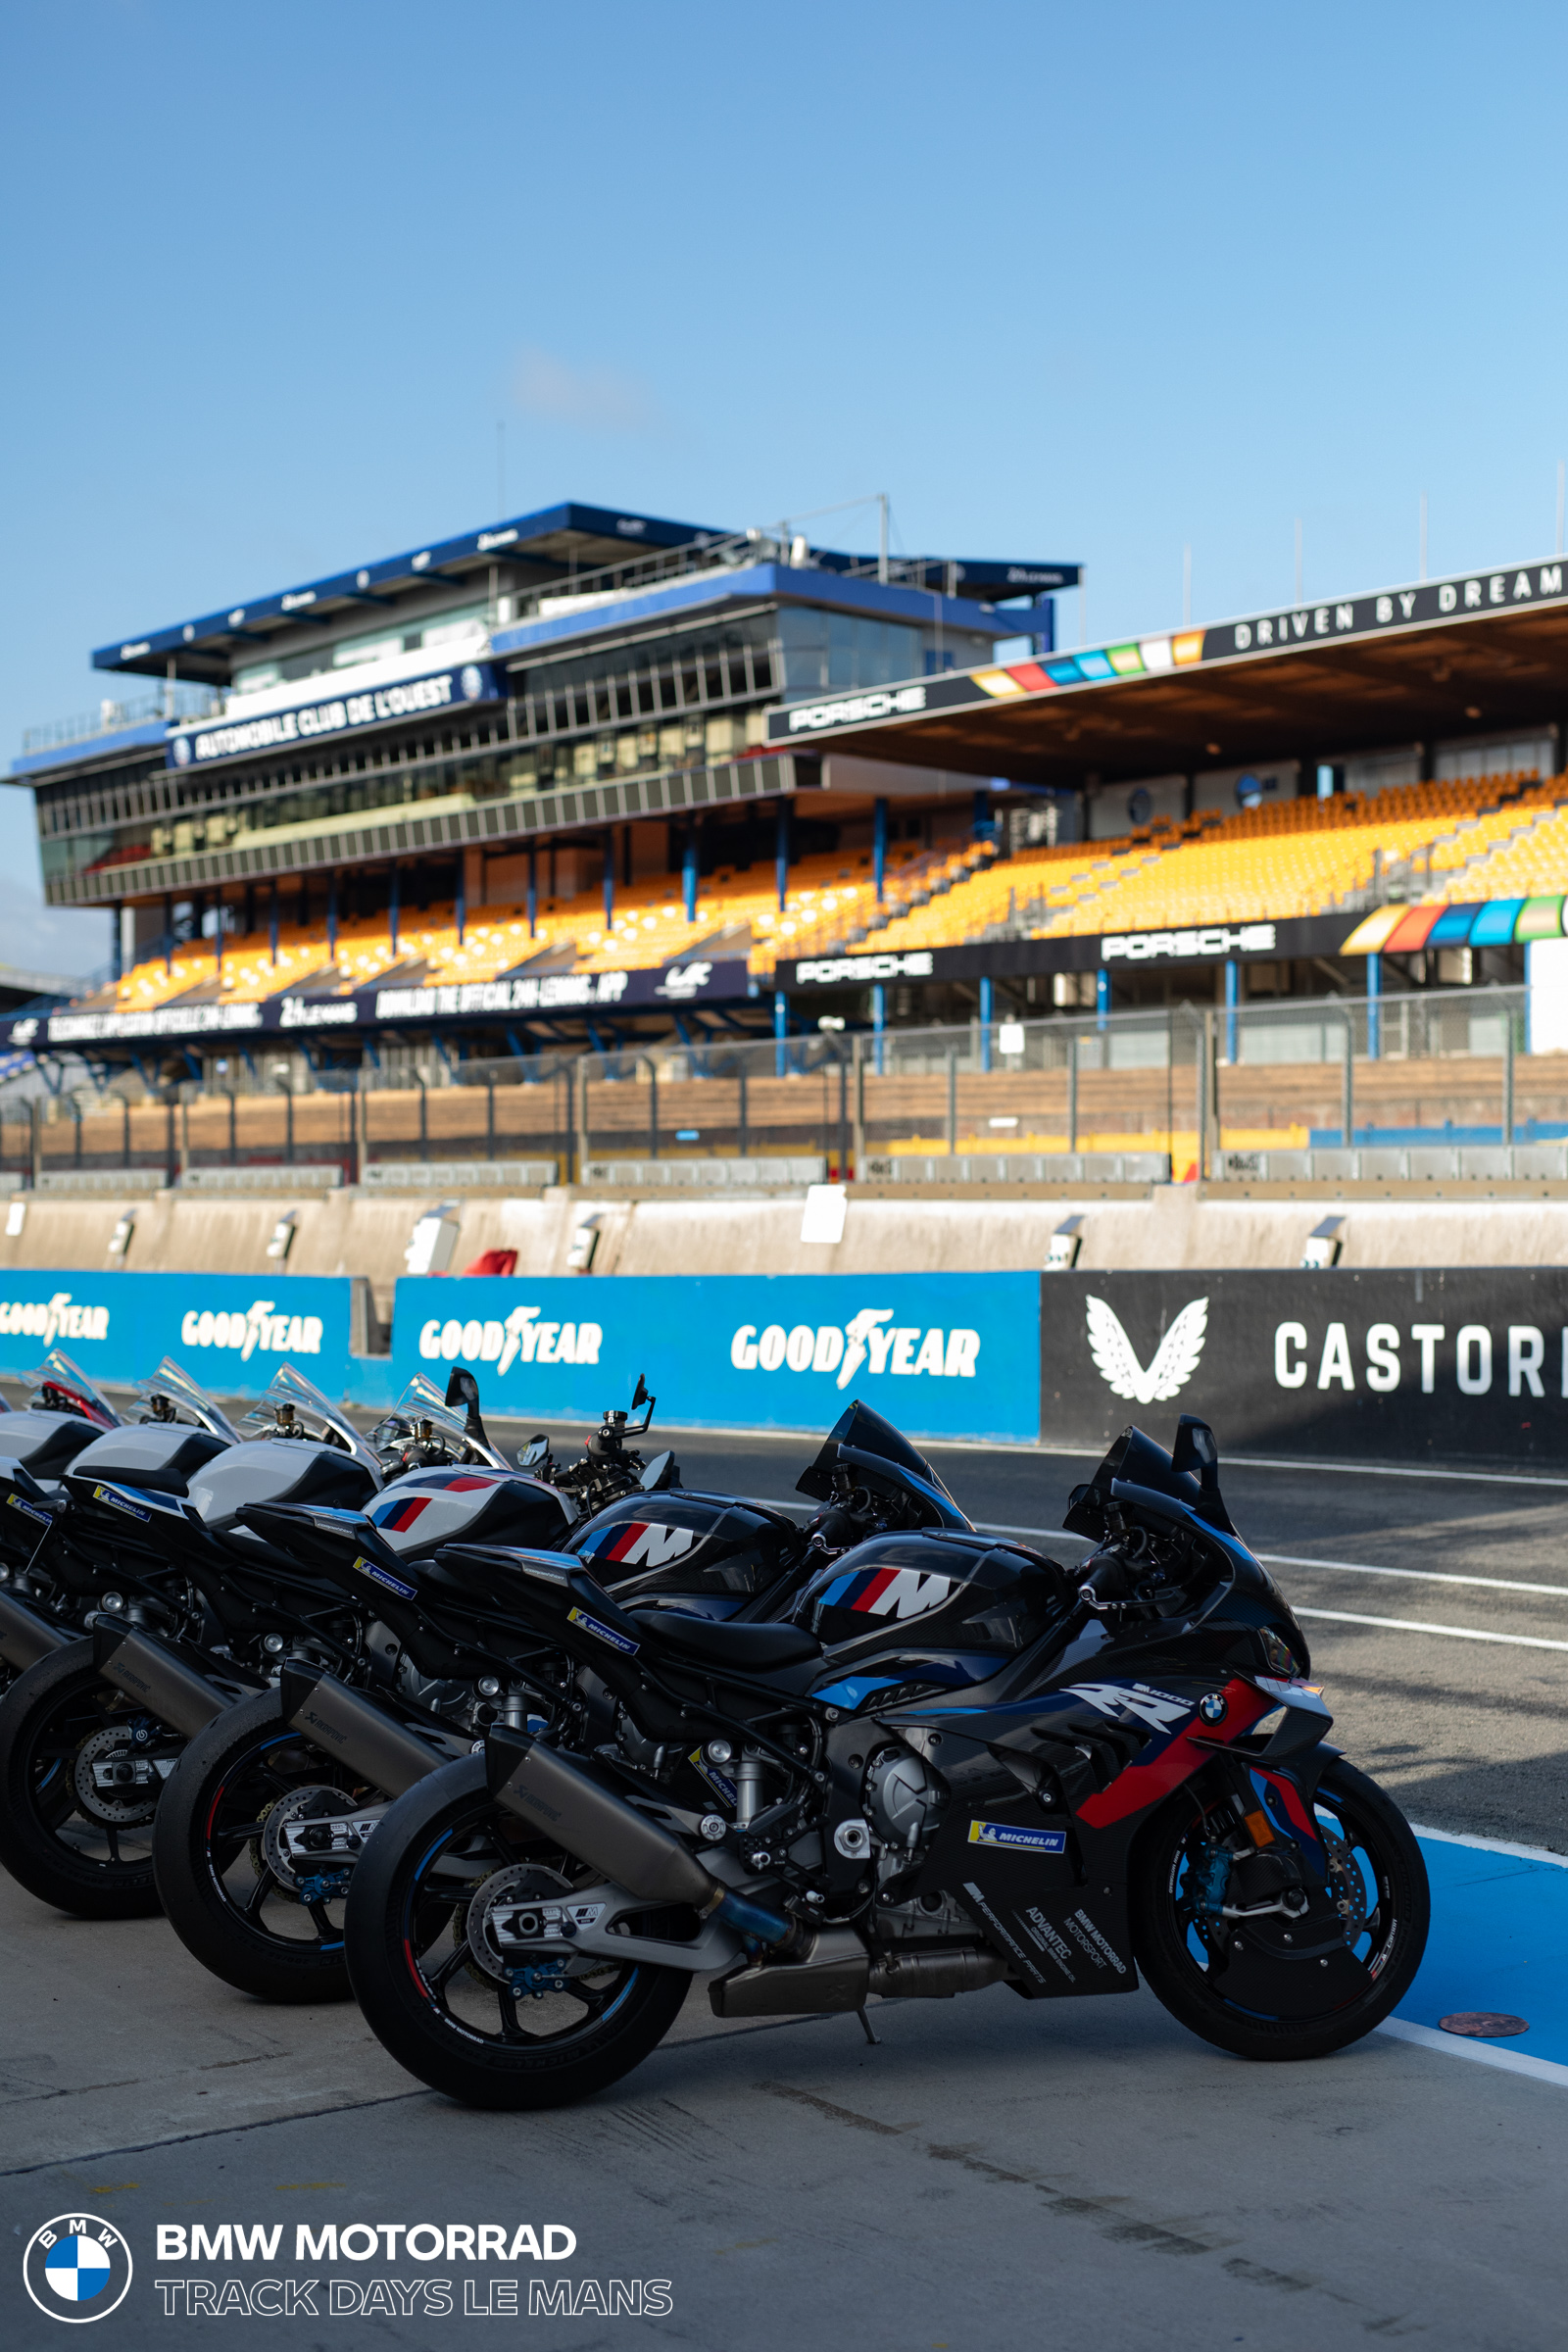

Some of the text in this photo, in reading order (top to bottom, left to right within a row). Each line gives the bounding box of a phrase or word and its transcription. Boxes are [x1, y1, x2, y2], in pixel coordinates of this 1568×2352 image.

[1235, 564, 1563, 650] DRIVEN BY DREAM
[195, 674, 453, 760] AUTOMOBILE CLUB DE L'OUEST
[789, 685, 927, 732] PORSCHE
[1101, 924, 1277, 961] PORSCHE
[796, 952, 934, 984] PORSCHE
[181, 1307, 323, 1355] GOODYEAR
[418, 1317, 603, 1365] GOODYEAR
[730, 1323, 980, 1378] GOODYEAR
[1274, 1321, 1568, 1398] CASTOR
[110, 1496, 146, 1517] MICHELIN
[317, 1522, 353, 1535] competition
[371, 1571, 410, 1595] MICHELIN
[524, 1568, 565, 1581] competition
[588, 1623, 631, 1650] MICHELIN
[998, 1832, 1059, 1846] MICHELIN
[212, 1876, 227, 1902] MOTORRAD
[980, 1901, 1027, 1959] PERFORMANCE
[1023, 1959, 1047, 1984] PARTS
[1026, 1907, 1072, 1960] ADVANTEC
[1031, 1926, 1051, 1951] ORIGINAL
[1055, 1959, 1071, 1977] ENGINE
[1063, 1917, 1107, 1970] MOTORSPORT
[1074, 1908, 1126, 1975] BMW MOTORRAD
[444, 2018, 458, 2030] BMW
[456, 2026, 484, 2044] MOTORRAD
